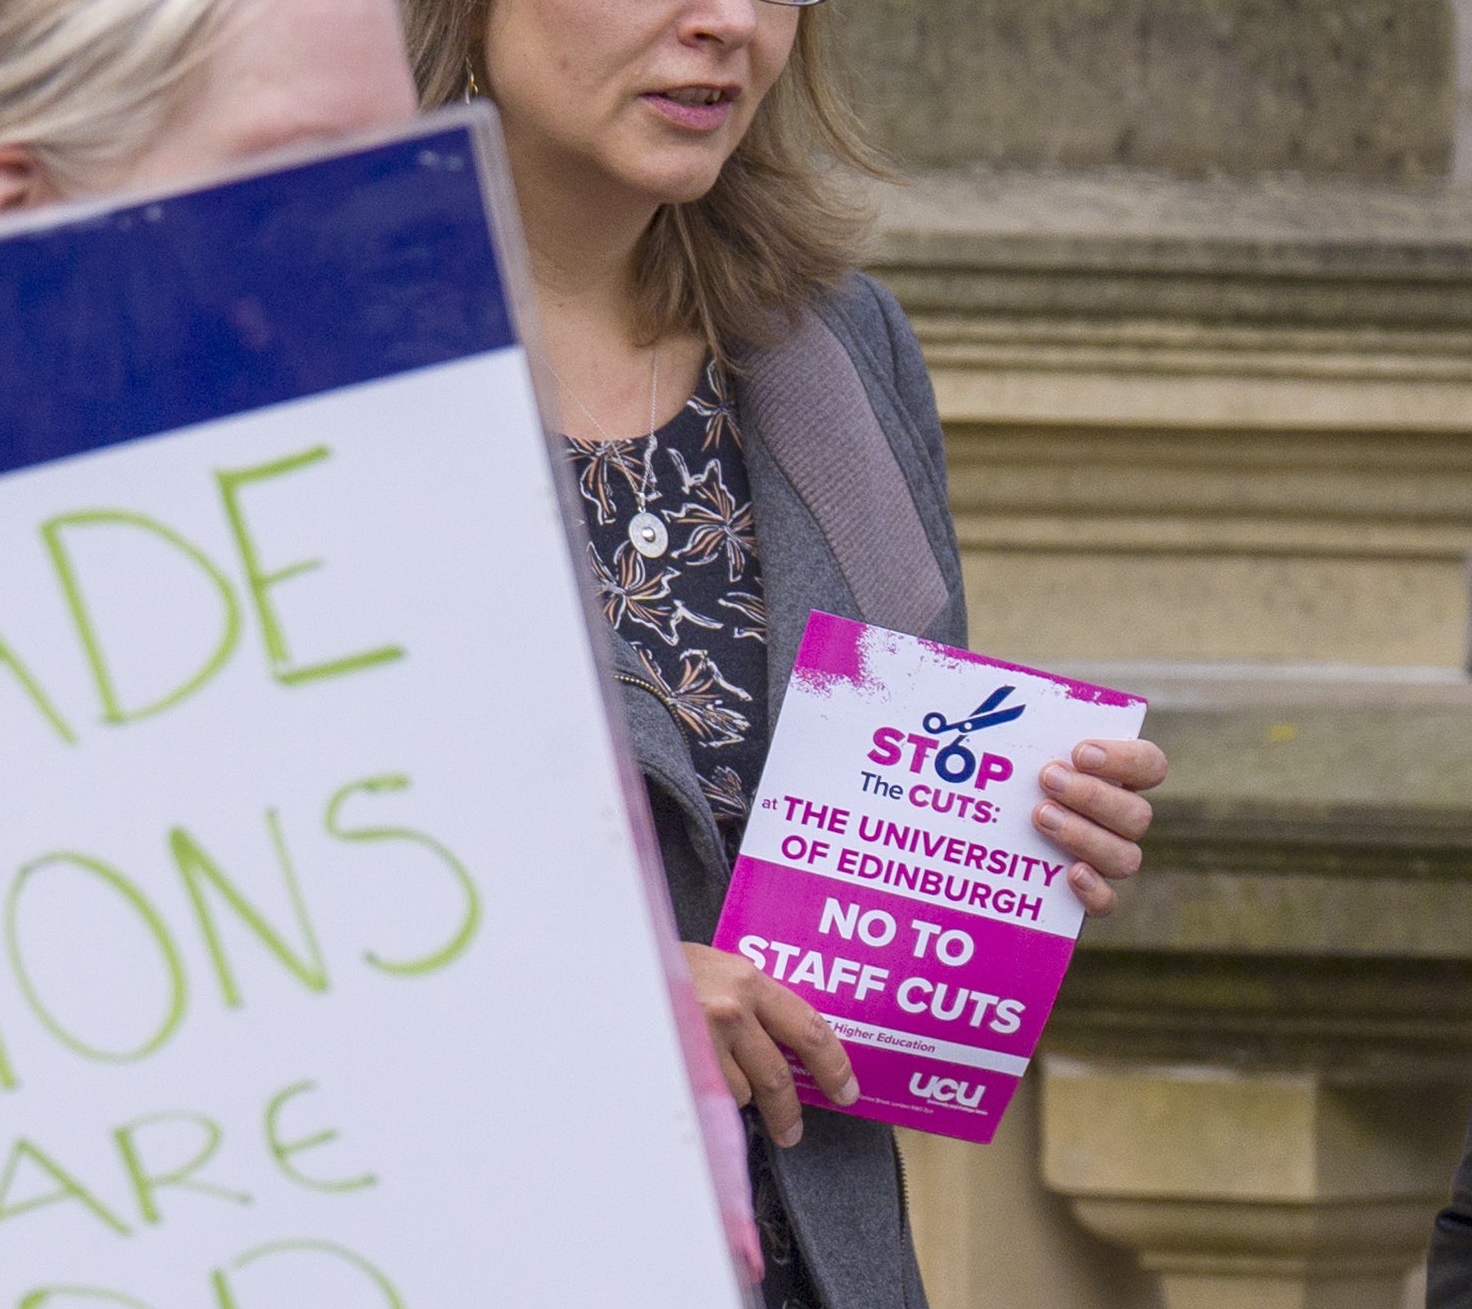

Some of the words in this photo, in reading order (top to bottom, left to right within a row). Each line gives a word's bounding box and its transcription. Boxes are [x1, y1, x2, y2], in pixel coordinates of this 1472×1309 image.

[866, 726, 1014, 790] STOP
[860, 769, 904, 801] The
[908, 783, 1001, 824] CUTS:
[762, 797, 778, 812] at
[783, 795, 848, 835] THE
[857, 815, 1065, 888] UNIVERSITY
[781, 833, 828, 865] OF
[836, 845, 1043, 922] EDINBURGH
[818, 897, 897, 948] NO
[909, 918, 975, 967] TO
[737, 934, 889, 1002] STAFF
[895, 976, 1027, 1035] CUTS
[834, 1022, 875, 1041] Higher
[876, 1032, 936, 1053] Education
